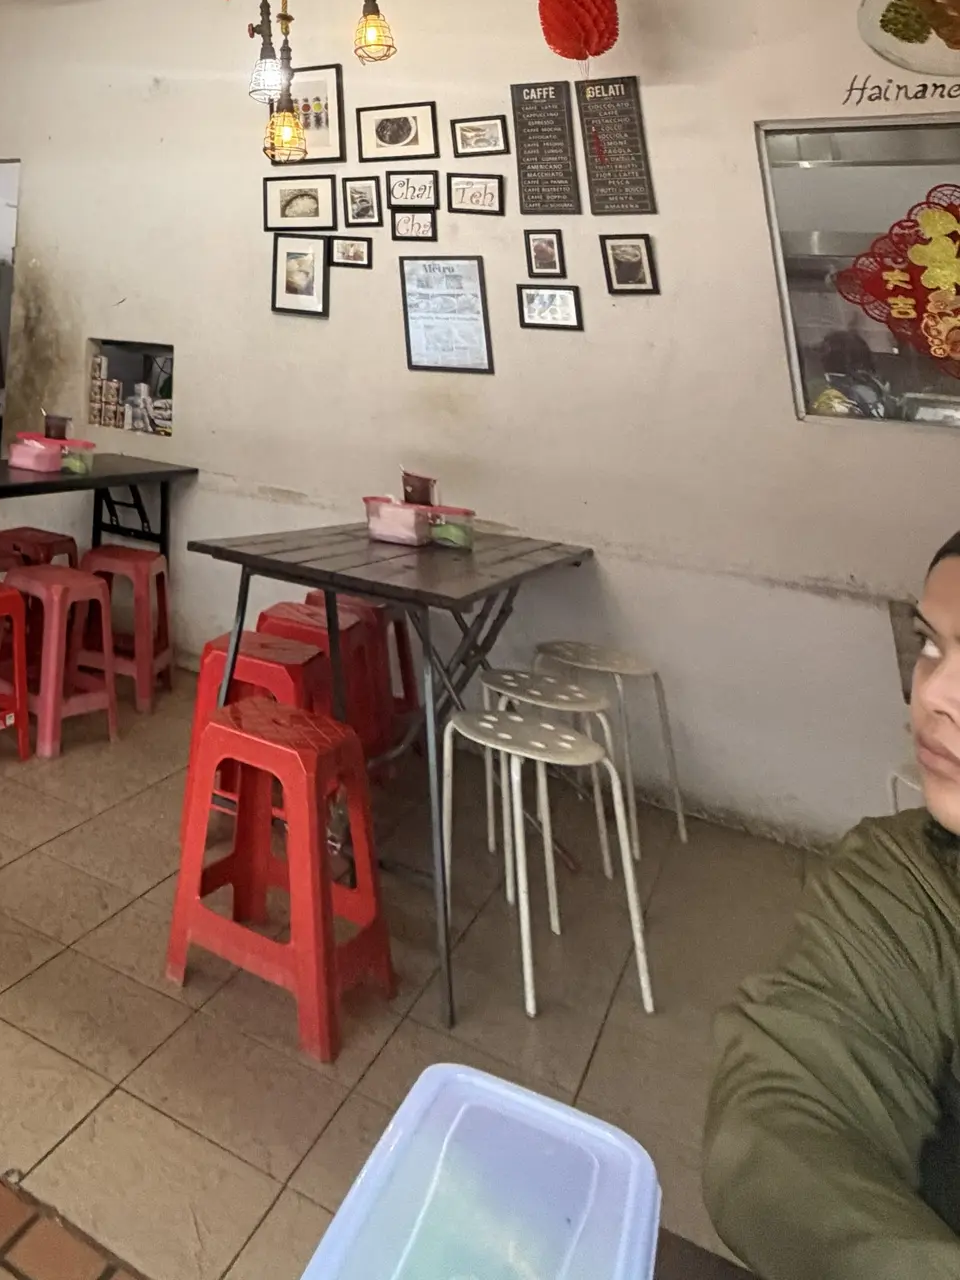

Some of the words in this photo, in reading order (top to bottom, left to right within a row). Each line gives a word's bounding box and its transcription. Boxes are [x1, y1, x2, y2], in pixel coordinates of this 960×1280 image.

[588, 84, 625, 99] GELATI
[391, 178, 433, 200] Chai
[396, 214, 431, 236] Cha
